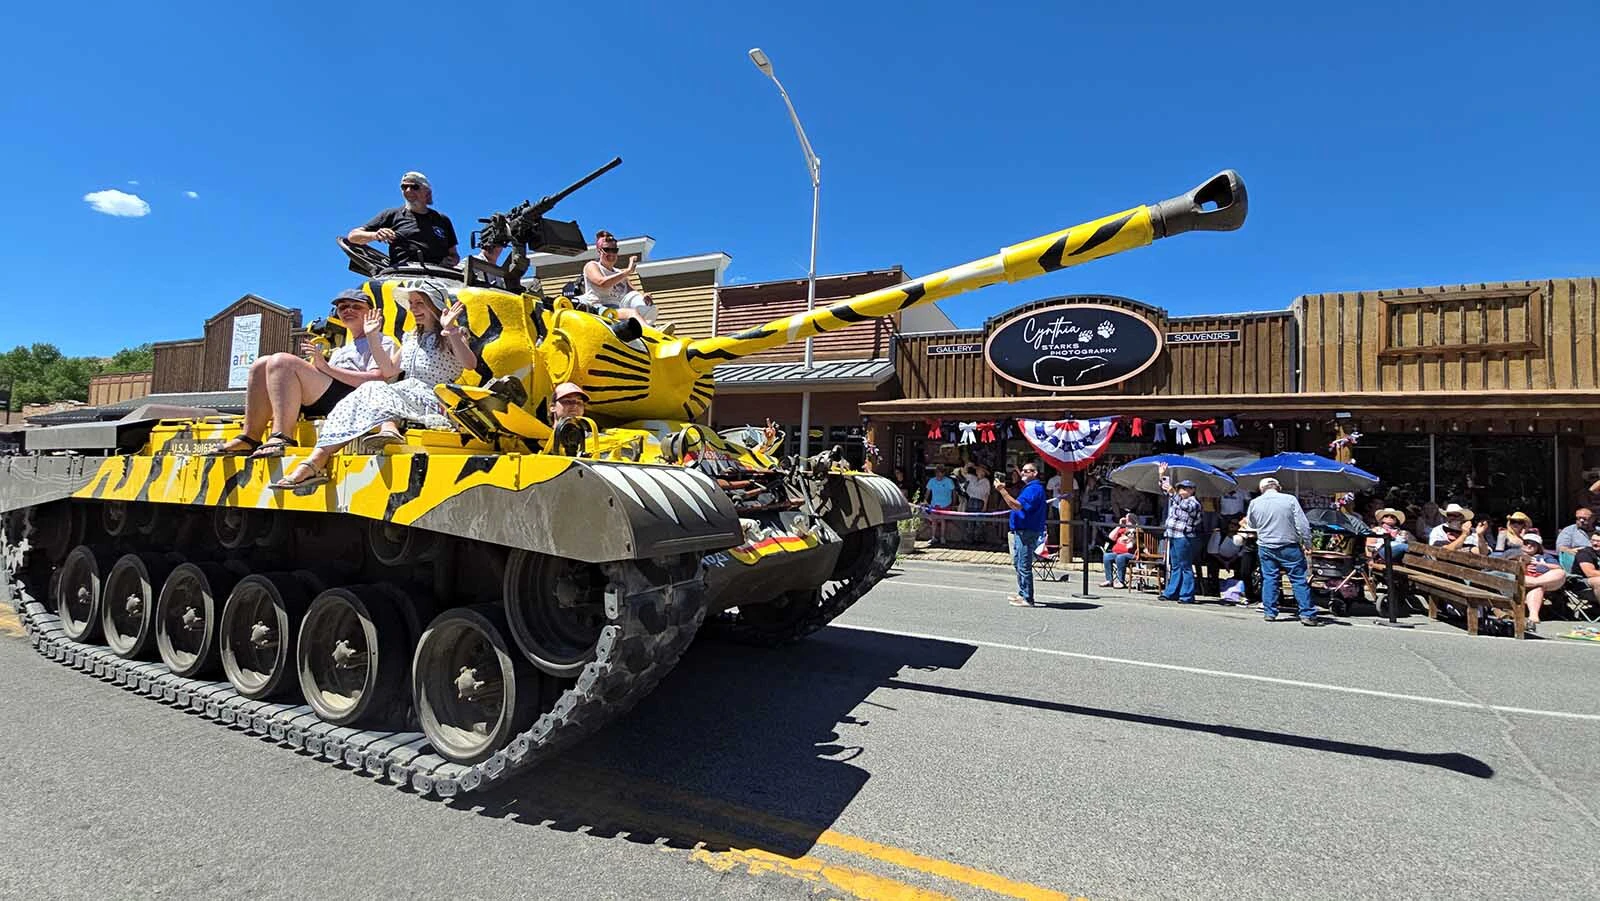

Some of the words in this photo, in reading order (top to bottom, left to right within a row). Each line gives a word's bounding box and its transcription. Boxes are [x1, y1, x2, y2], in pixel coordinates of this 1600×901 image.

[1023, 316, 1082, 350] Cynthia
[1174, 332, 1231, 342] SOUVENIRS
[935, 345, 973, 354] GALLERY
[1041, 343, 1080, 351] STARKS
[1050, 347, 1118, 356] PHOTOGRAPHY
[233, 352, 255, 366] arts
